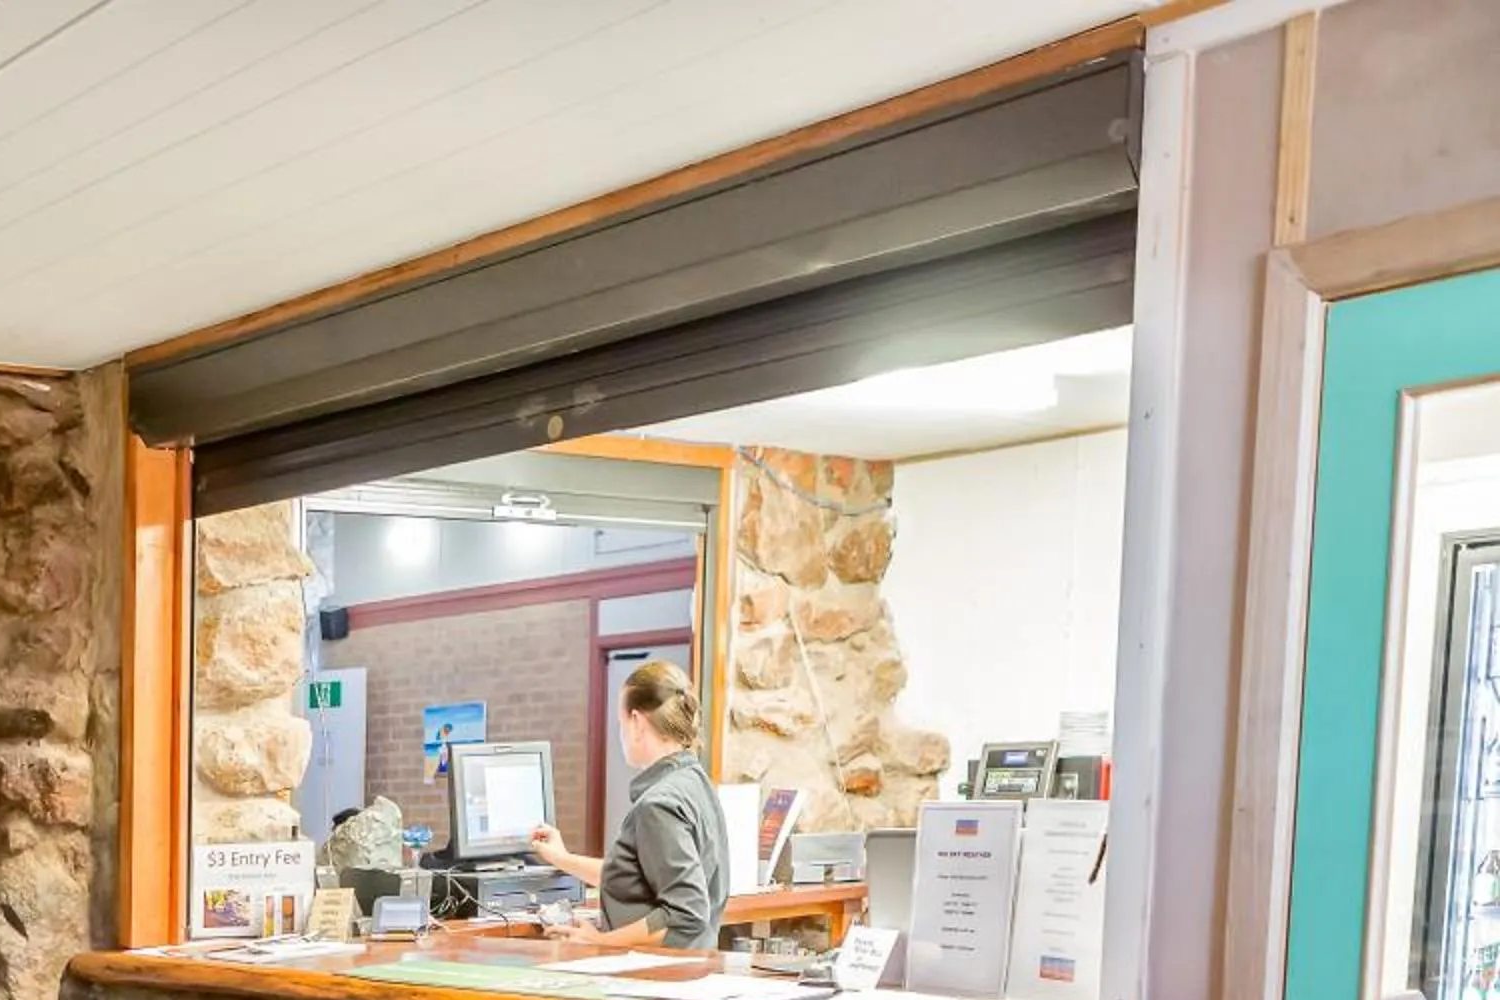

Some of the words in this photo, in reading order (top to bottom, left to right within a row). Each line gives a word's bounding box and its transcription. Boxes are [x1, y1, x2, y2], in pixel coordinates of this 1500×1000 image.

[207, 849, 226, 868] $3
[231, 850, 271, 868] Entry
[275, 849, 301, 866] Fee
